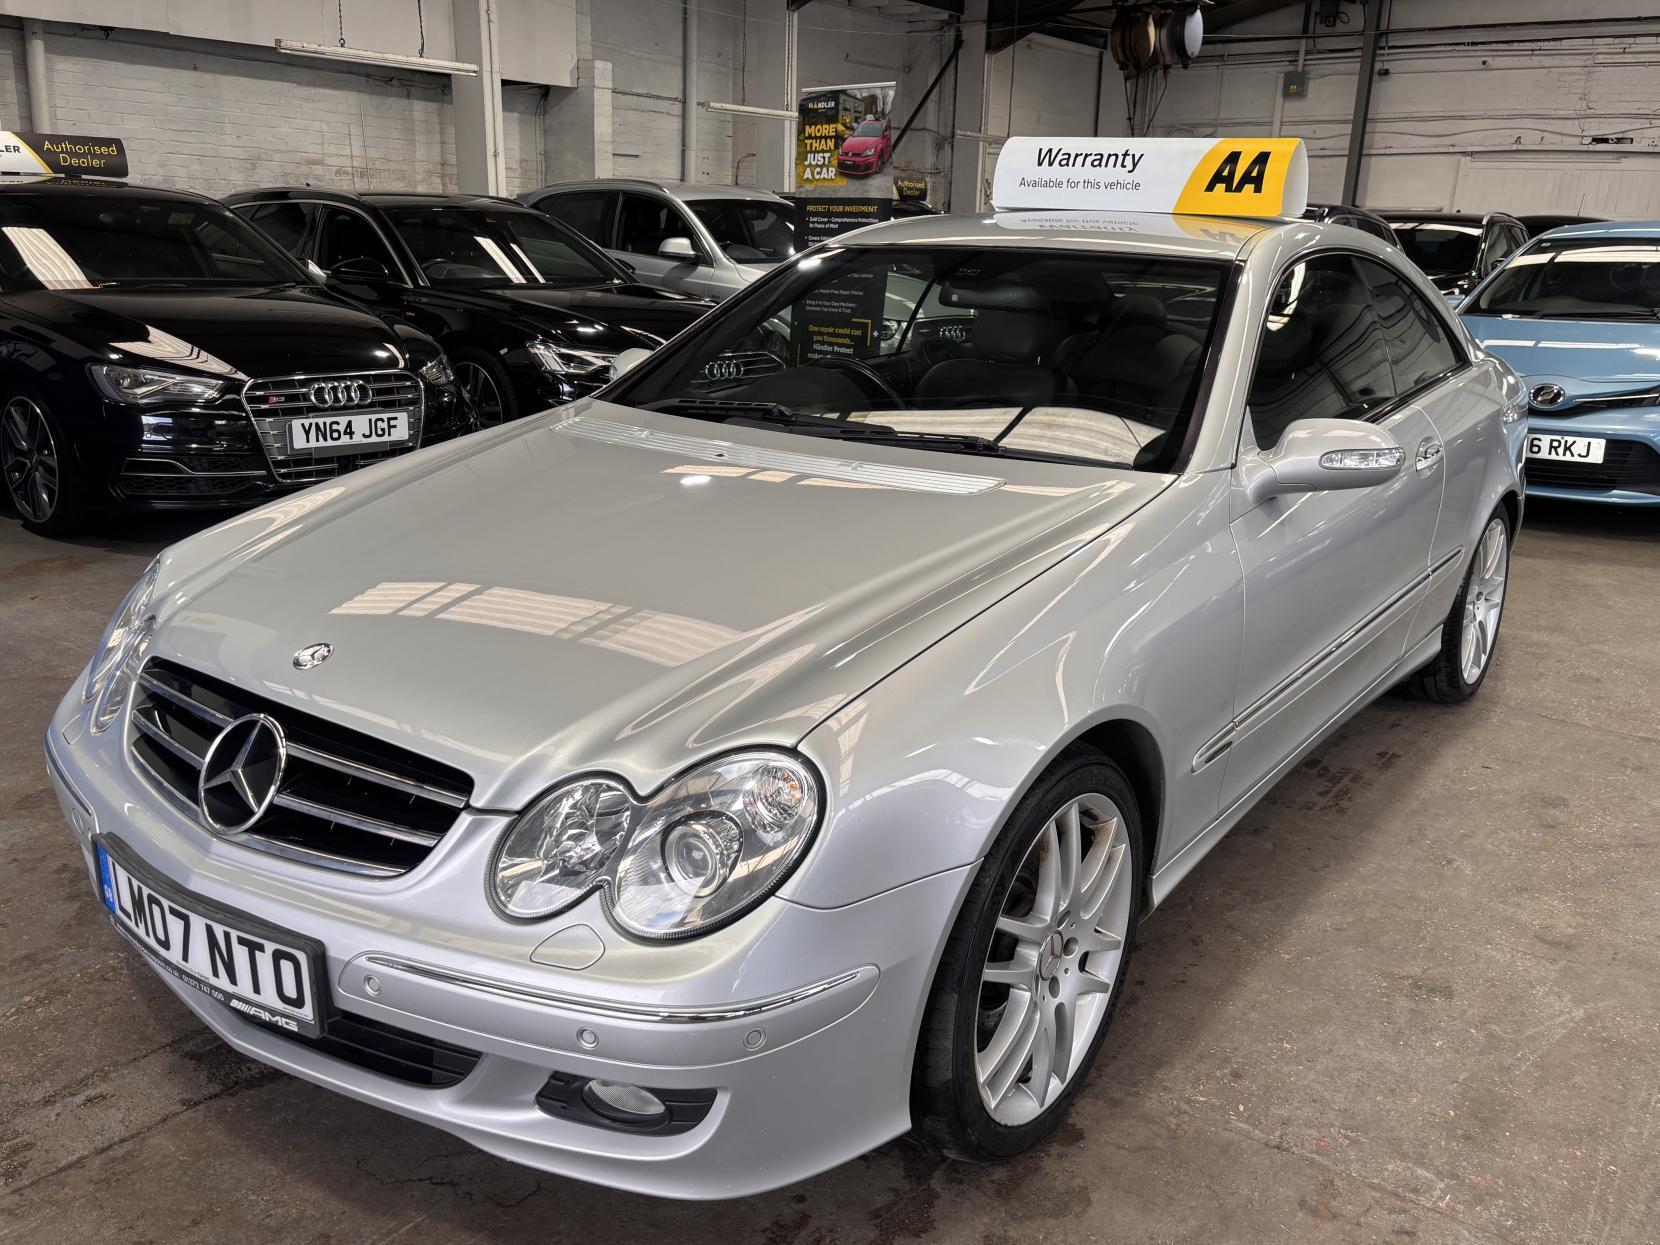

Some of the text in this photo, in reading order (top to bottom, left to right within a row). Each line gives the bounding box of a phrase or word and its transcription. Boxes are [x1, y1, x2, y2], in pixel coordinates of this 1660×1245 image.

[805, 124, 836, 137] MORE
[43, 140, 118, 155] Authorised
[804, 138, 835, 151] THAN
[59, 153, 106, 168] Dealer
[804, 152, 831, 166] JUST
[1035, 147, 1145, 173] Warranty
[803, 167, 836, 180] A CAR
[1203, 150, 1272, 194] AA
[897, 179, 925, 188] Authorised
[1019, 177, 1141, 191] Available for this vehicle
[903, 187, 921, 197] Dealer
[844, 205, 878, 213] INVESTMENT
[808, 324, 862, 336] One repair could cost
[833, 345, 854, 354] Protect
[301, 416, 399, 444] YN64 JGF
[1547, 438, 1592, 459] RKJ
[111, 860, 192, 964] LM07
[204, 922, 306, 1010] NTO
[250, 1007, 299, 1032] AMG
